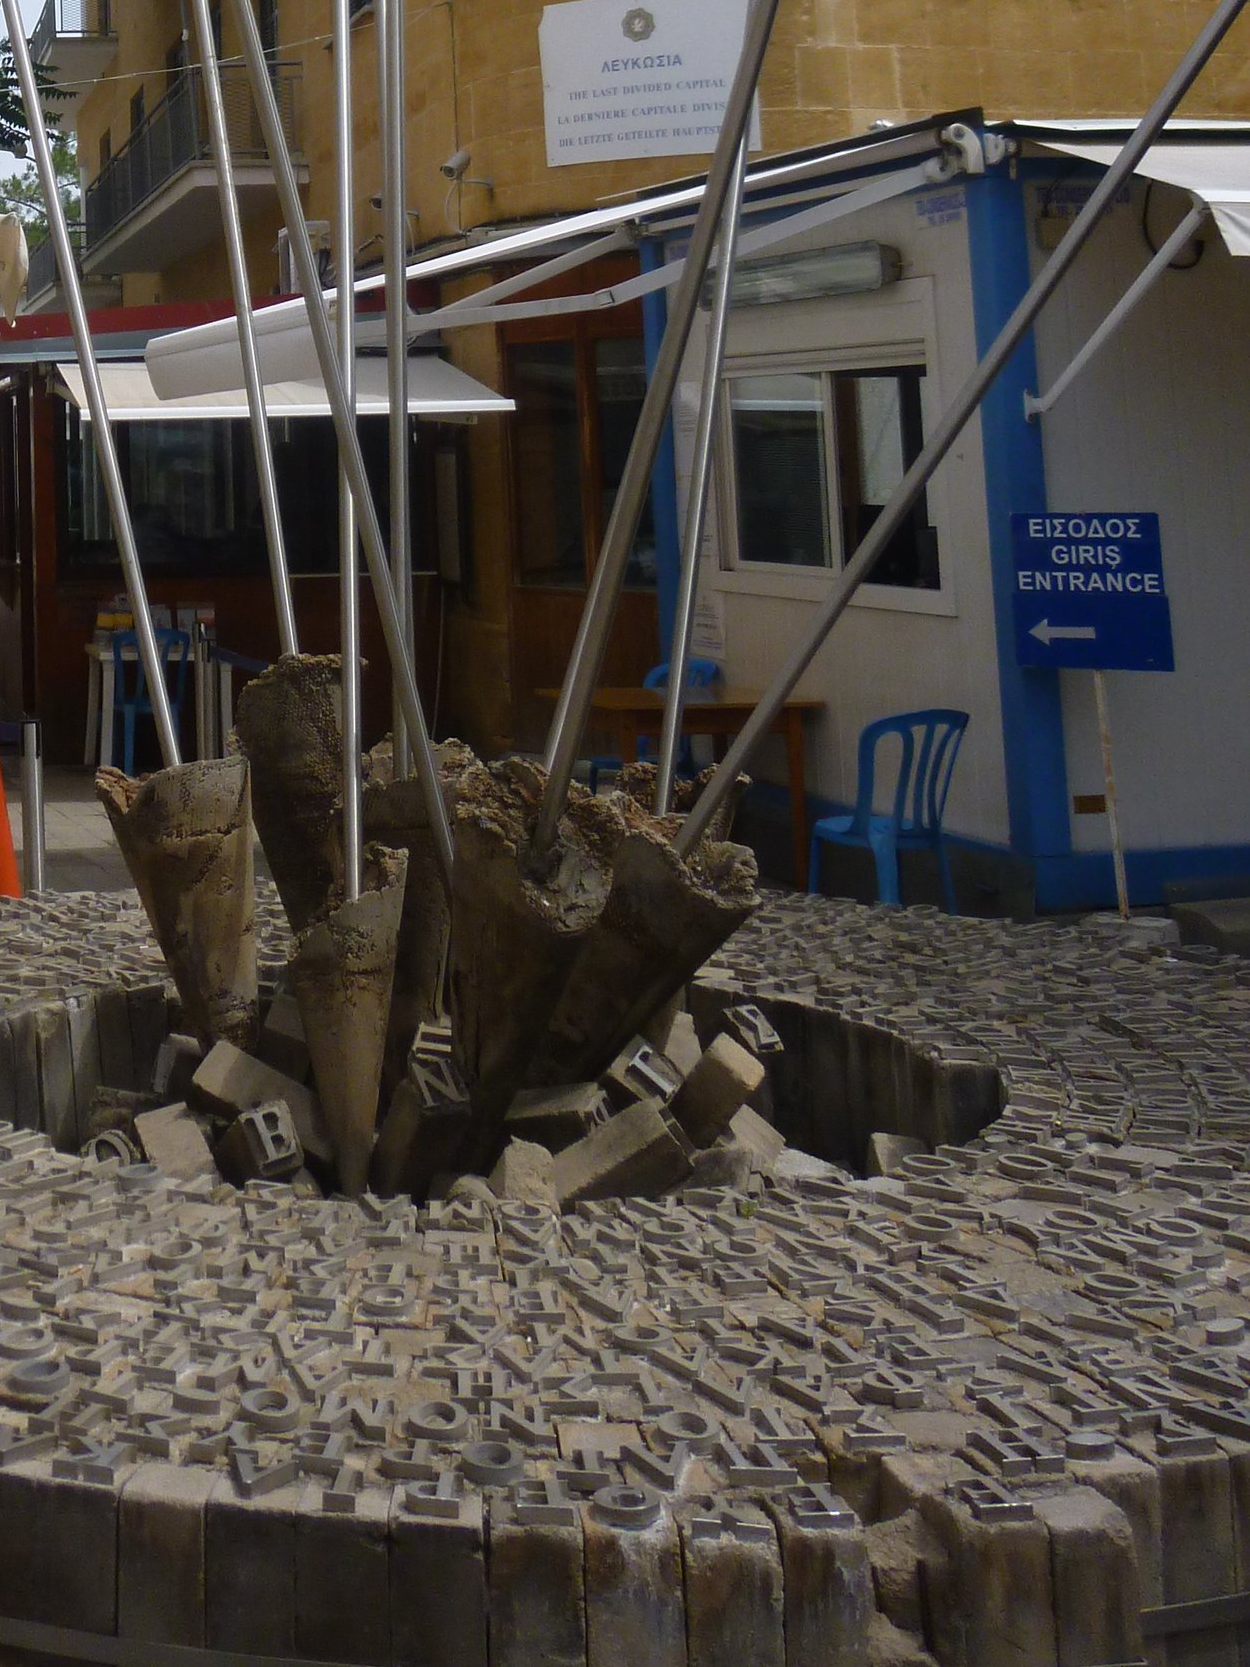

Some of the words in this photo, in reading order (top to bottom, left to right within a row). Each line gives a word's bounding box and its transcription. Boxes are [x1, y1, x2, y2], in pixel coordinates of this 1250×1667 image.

[601, 54, 682, 73] ΛΕΥΚΩΣΙΑ
[568, 91, 589, 101] THE
[593, 86, 619, 99] LAST
[622, 81, 671, 95] DIVIDED
[676, 77, 726, 90] CAPITAL
[557, 115, 570, 125] LA
[573, 109, 627, 123] DERNIERE
[632, 103, 687, 116] CAPITALE
[559, 136, 575, 147] DIE
[578, 133, 614, 146] LETZTE
[617, 128, 668, 141] GETEILTE
[1028, 518, 1141, 538] ΕΙΣΟΔΟΣ
[1051, 545, 1121, 569] GIRIŞ
[1017, 571, 1161, 593] ENTRANCE
